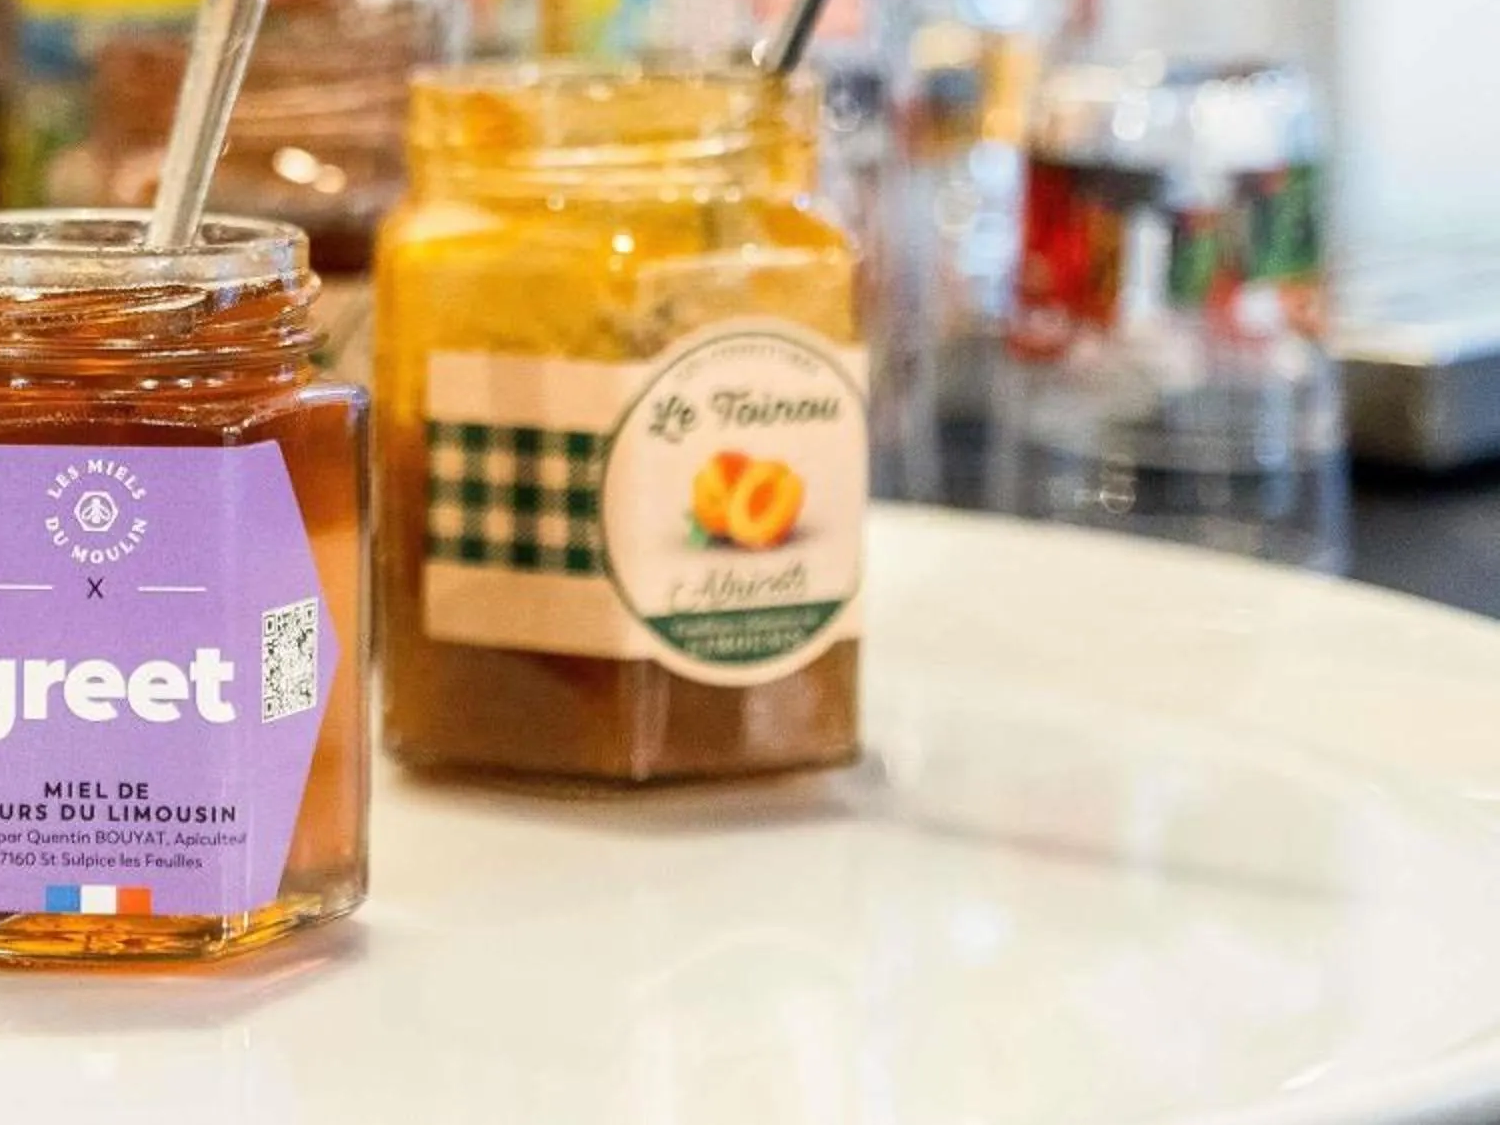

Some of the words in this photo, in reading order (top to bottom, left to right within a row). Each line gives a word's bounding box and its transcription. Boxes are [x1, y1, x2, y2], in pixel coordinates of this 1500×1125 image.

[47, 465, 79, 499] LES
[87, 459, 147, 500] MIELS
[45, 516, 70, 546] DU
[71, 517, 148, 564] MOULIN
[43, 781, 108, 799] MIEL
[118, 782, 149, 800] DE
[60, 803, 95, 822] DU
[108, 805, 236, 824] LIMOUSIN
[26, 829, 91, 845] Quentin
[40, 852, 58, 867] St
[61, 852, 117, 868] Sulpice
[120, 852, 141, 868] les
[145, 853, 203, 869] Feuilles
